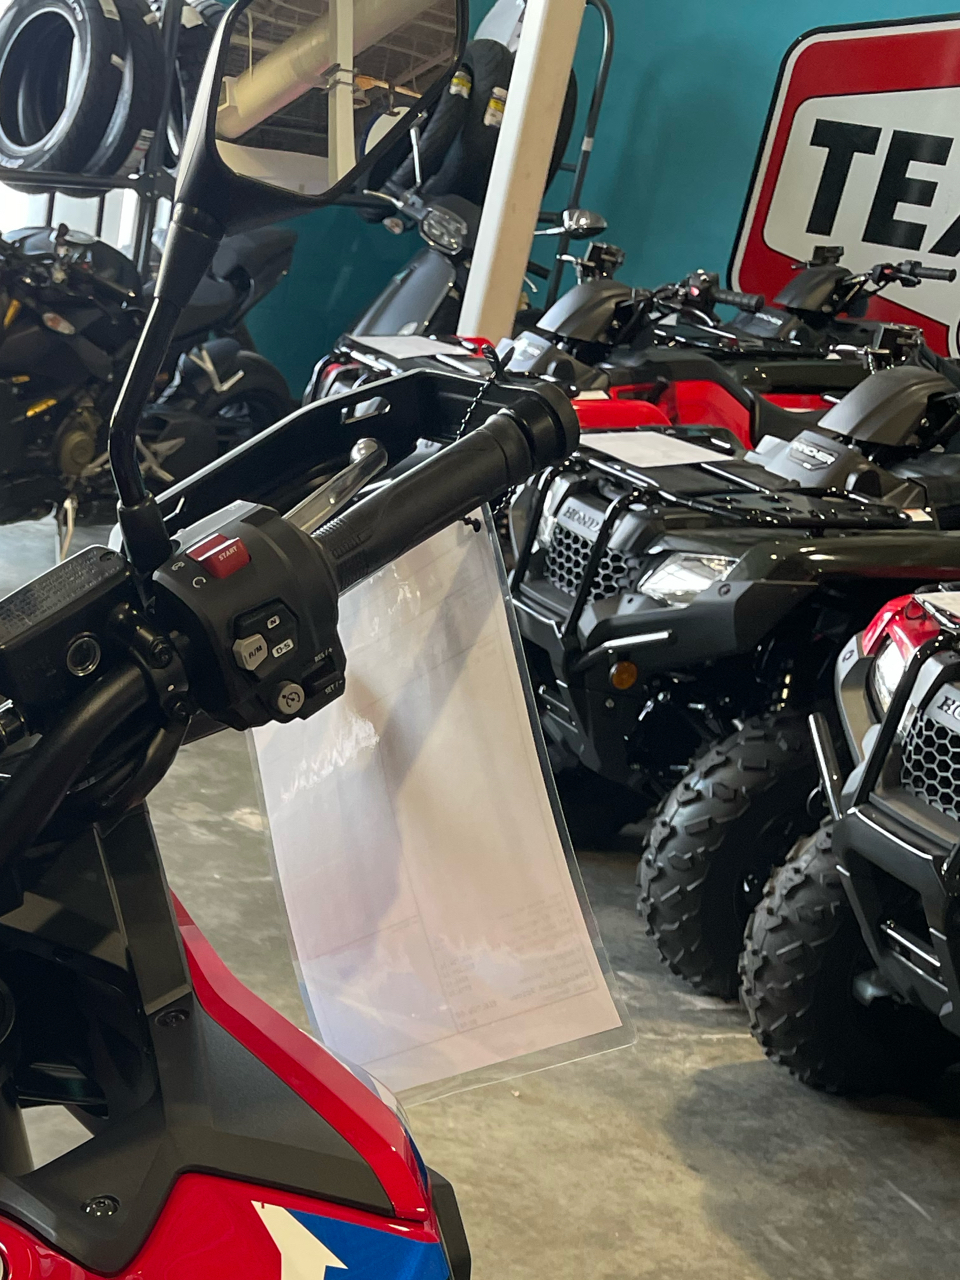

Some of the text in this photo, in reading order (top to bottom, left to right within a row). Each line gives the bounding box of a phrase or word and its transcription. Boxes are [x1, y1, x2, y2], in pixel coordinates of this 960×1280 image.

[805, 118, 960, 257] TE
[562, 506, 601, 533] HOND
[218, 546, 238, 561] START
